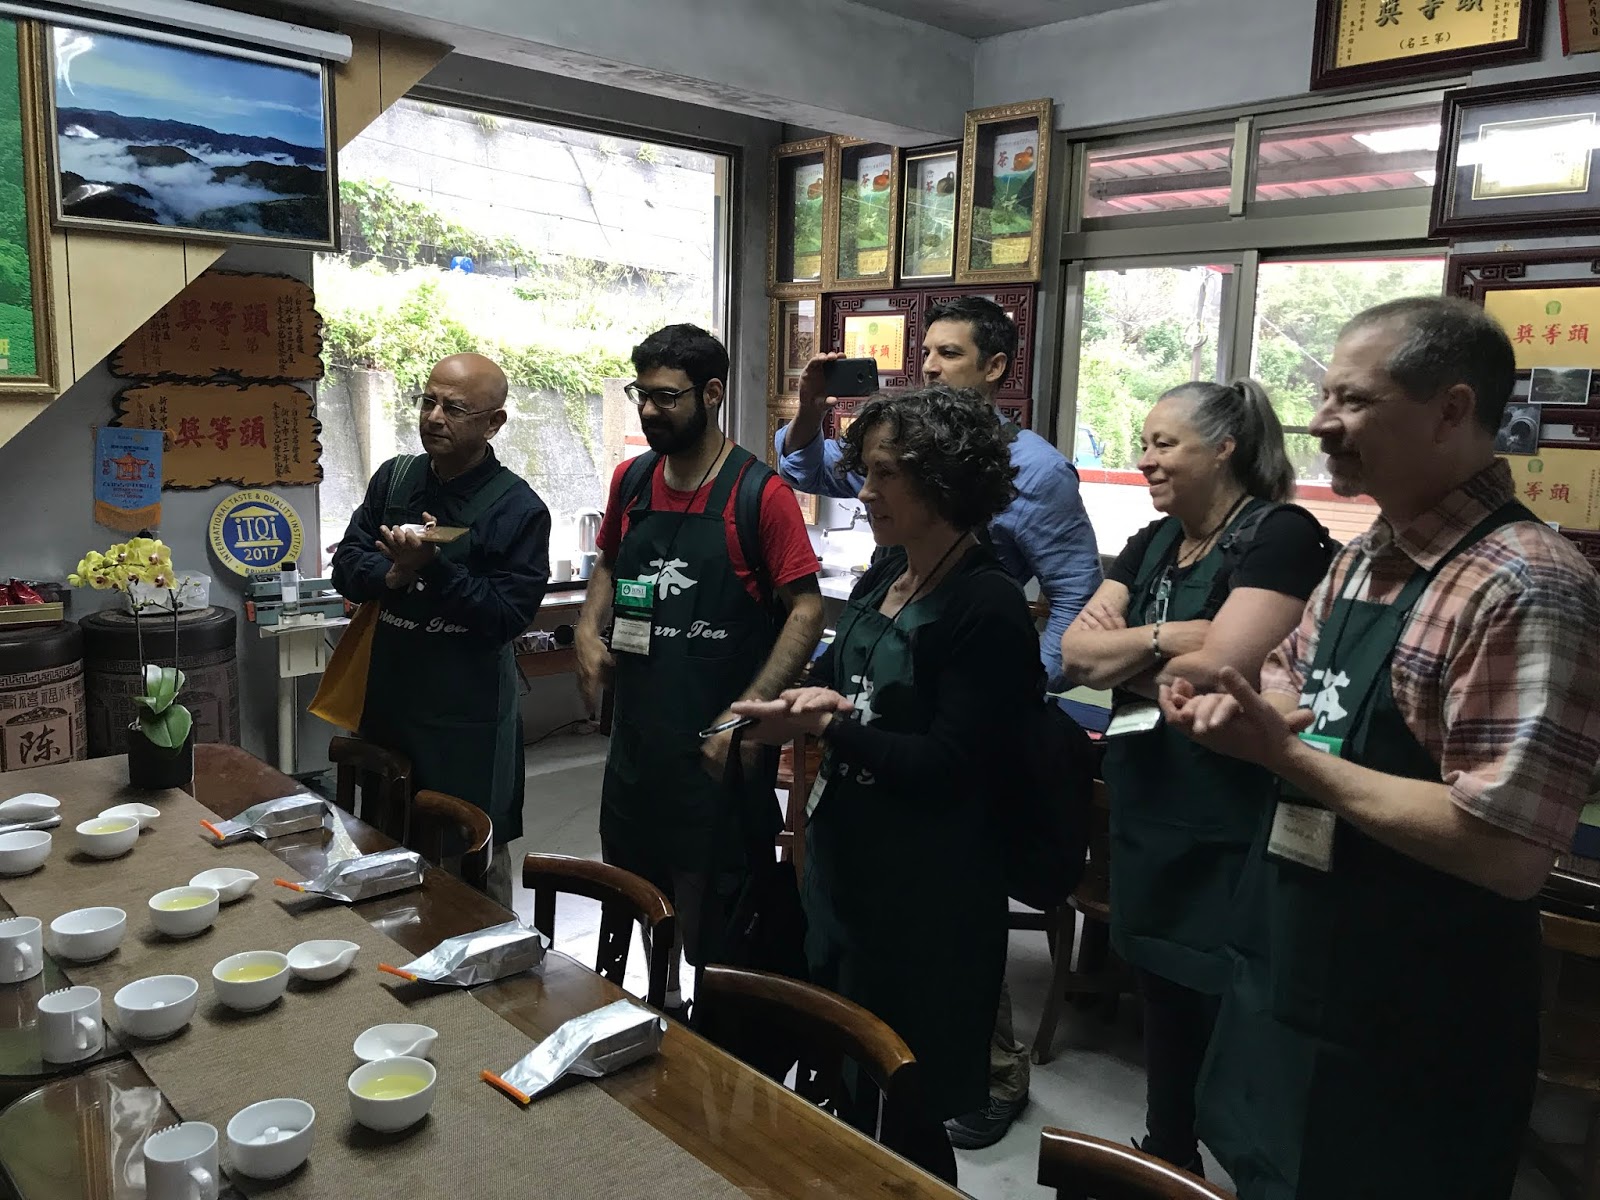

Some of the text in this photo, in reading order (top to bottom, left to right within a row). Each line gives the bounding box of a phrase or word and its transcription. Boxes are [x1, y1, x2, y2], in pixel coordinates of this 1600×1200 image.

[212, 504, 233, 563] INTERNATIONAL
[228, 493, 253, 505] TASTE
[263, 494, 294, 518] QUALITY
[289, 519, 301, 559] INSTITUTE
[243, 547, 279, 561] 2017
[686, 620, 728, 639] Tea
